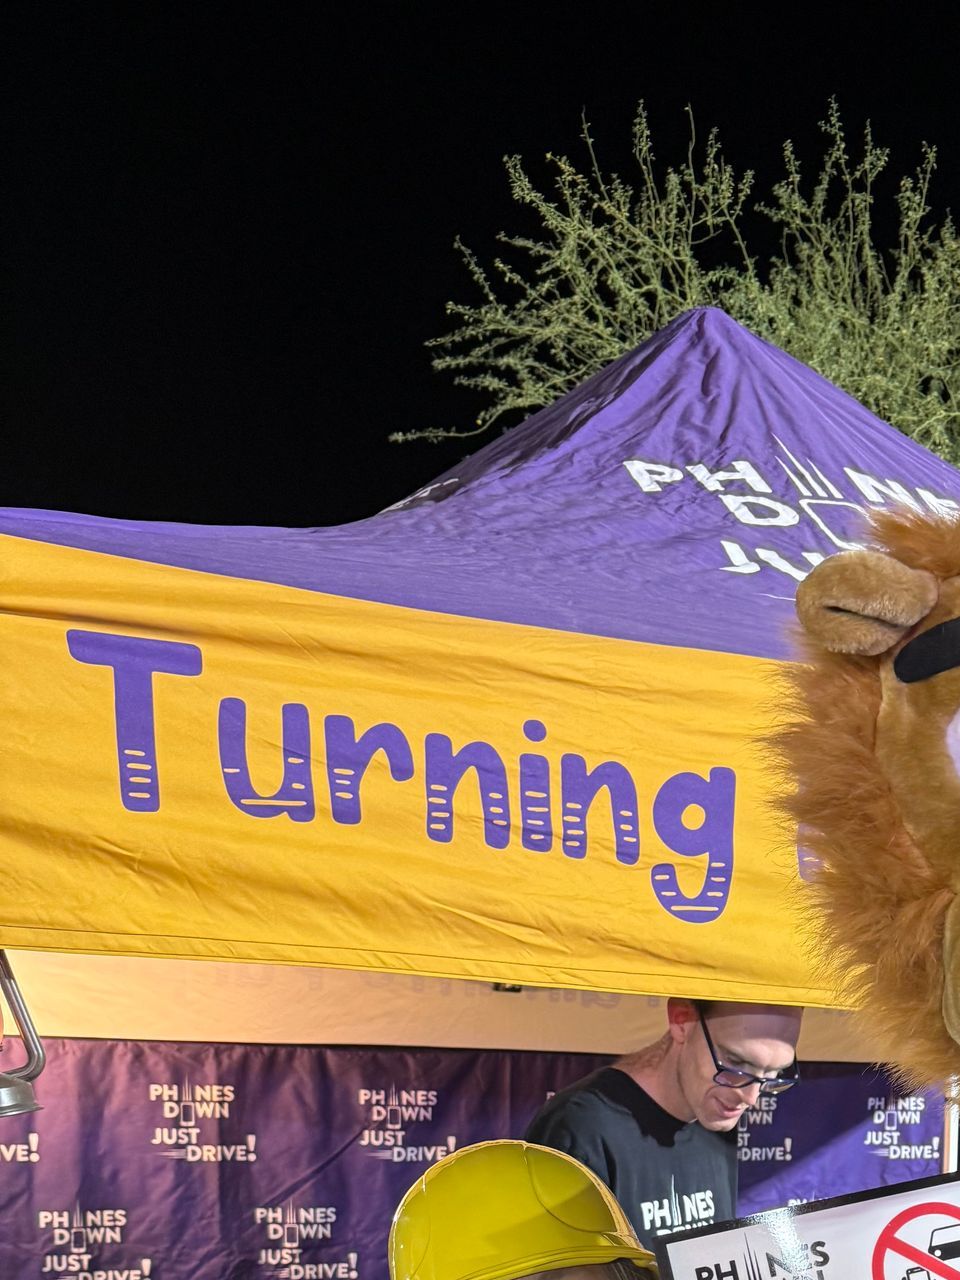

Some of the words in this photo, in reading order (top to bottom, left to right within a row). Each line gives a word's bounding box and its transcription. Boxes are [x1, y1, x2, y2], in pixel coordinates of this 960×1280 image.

[67, 628, 737, 924] Turning
[0, 1132, 40, 1163] VE!
[151, 1127, 201, 1145] JUST
[360, 1129, 406, 1147] JUST
[863, 1131, 900, 1145] JUST
[889, 1136, 940, 1159] DRIVE!
[186, 1134, 257, 1162] DRIVE!
[741, 1137, 793, 1161] DRIVE!
[41, 1254, 92, 1273] JUST
[257, 1248, 303, 1265] JUST
[289, 1252, 359, 1280] DRIVE!
